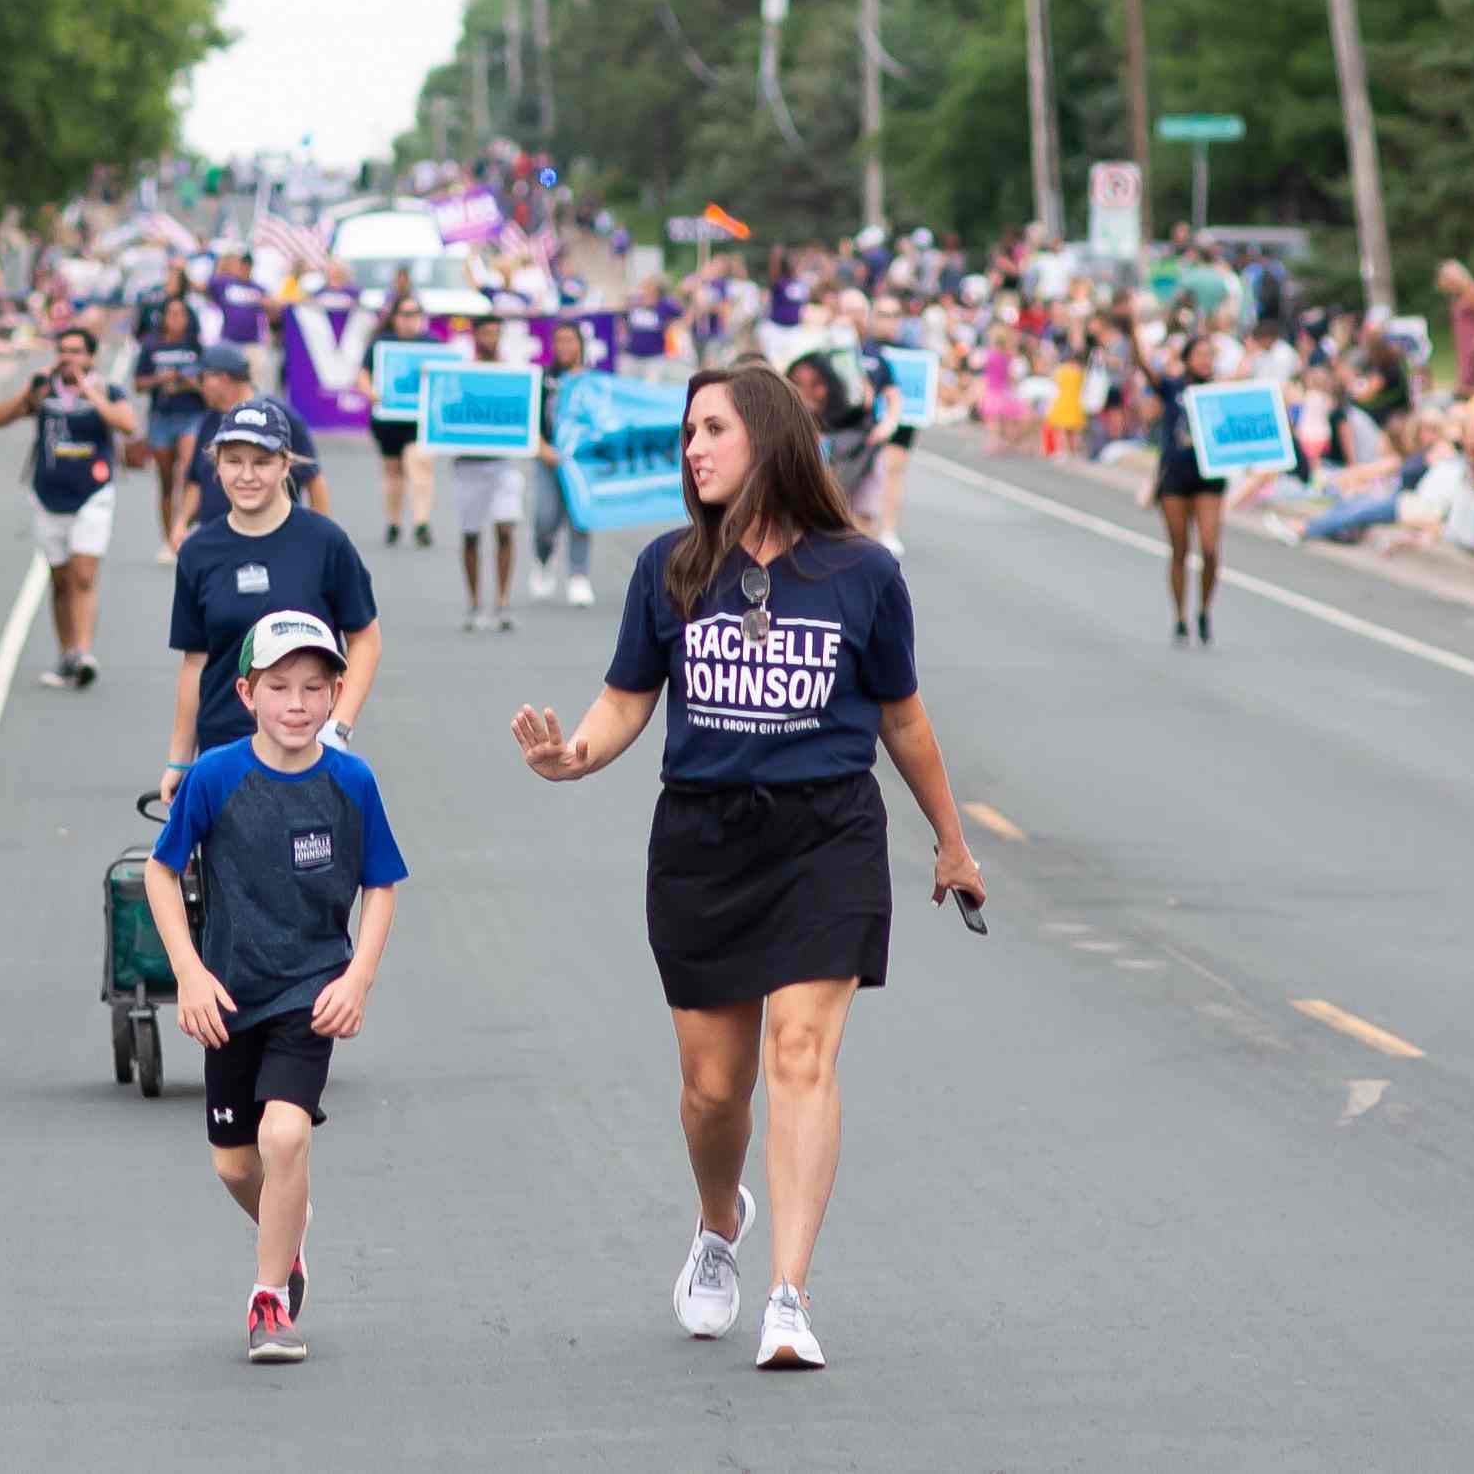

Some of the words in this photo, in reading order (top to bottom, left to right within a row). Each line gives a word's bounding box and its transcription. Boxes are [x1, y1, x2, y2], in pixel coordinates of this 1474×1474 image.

[684, 661, 836, 710] JOHNSON
[693, 714, 721, 730] MAPLE
[723, 718, 756, 734] GROVE
[759, 722, 782, 735] CITY
[784, 717, 821, 733] COUNCIL
